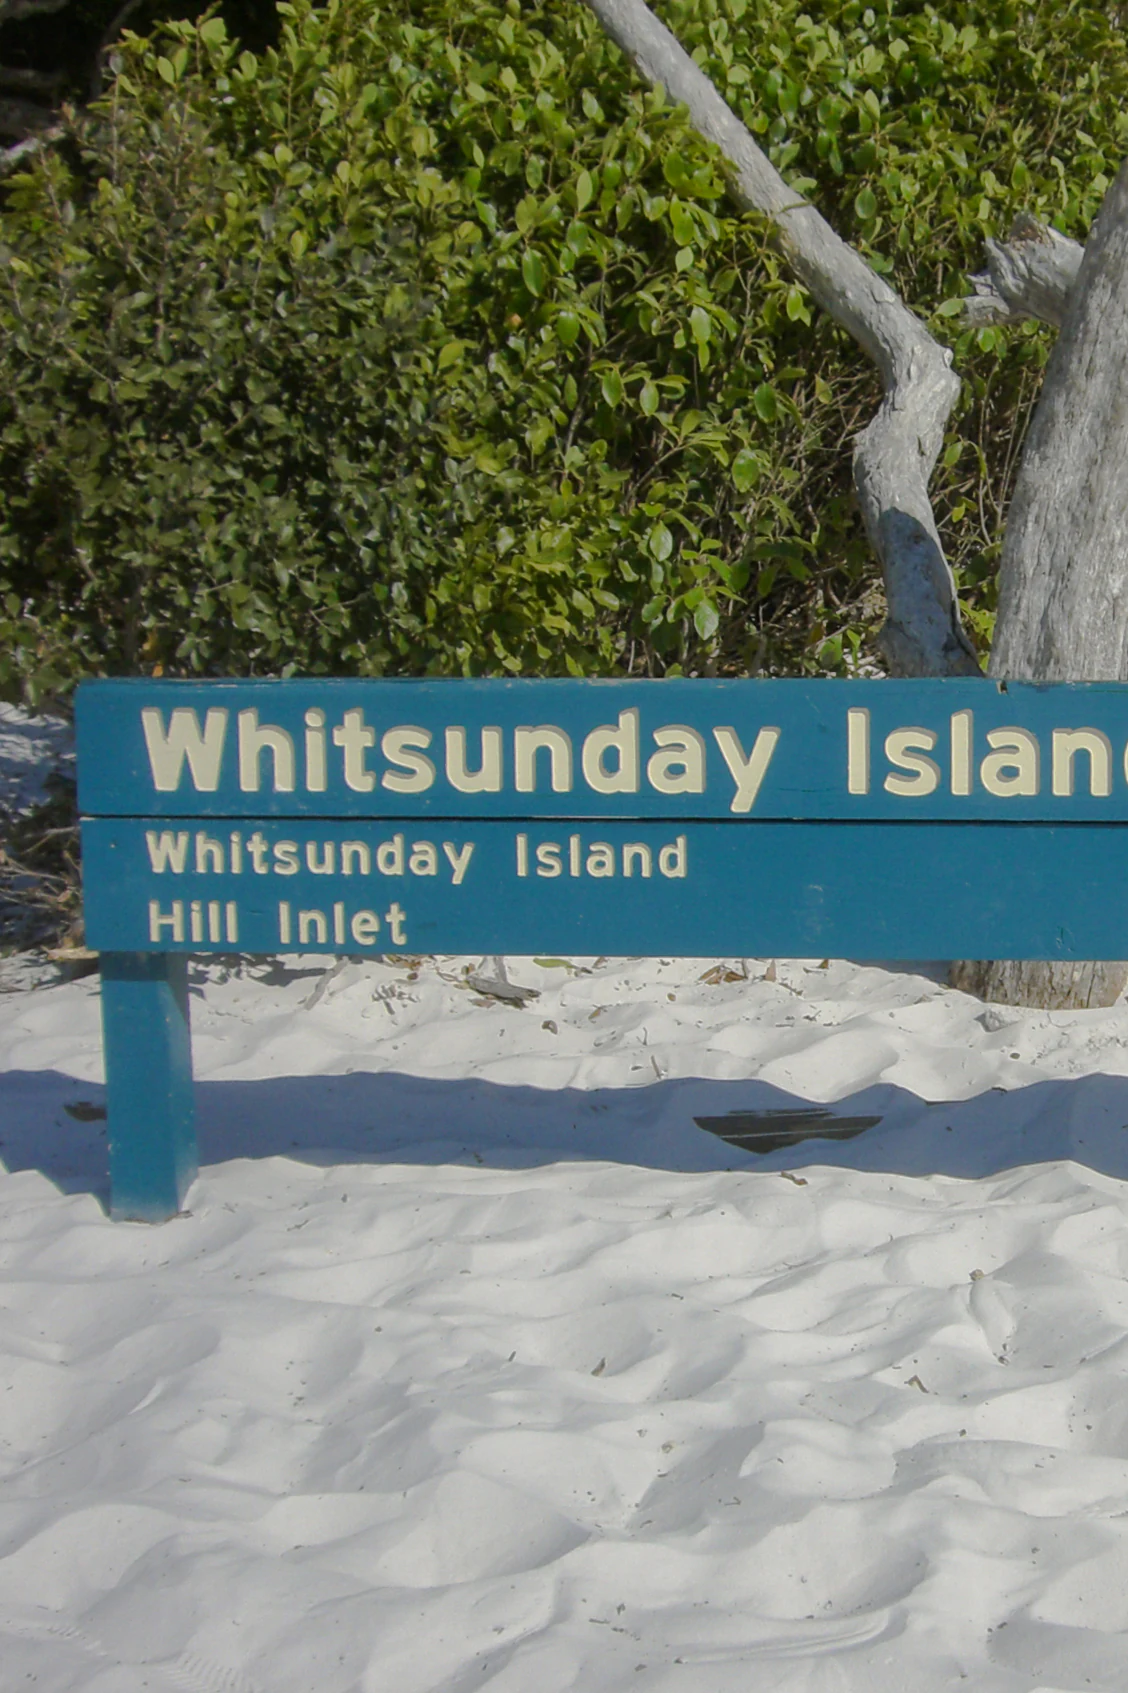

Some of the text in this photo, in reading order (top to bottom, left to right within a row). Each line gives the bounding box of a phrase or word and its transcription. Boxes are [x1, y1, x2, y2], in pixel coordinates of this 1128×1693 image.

[142, 707, 780, 813] Whitsunday
[145, 832, 688, 885] Whitsunday Island
[148, 901, 407, 945] Hill Inlet
